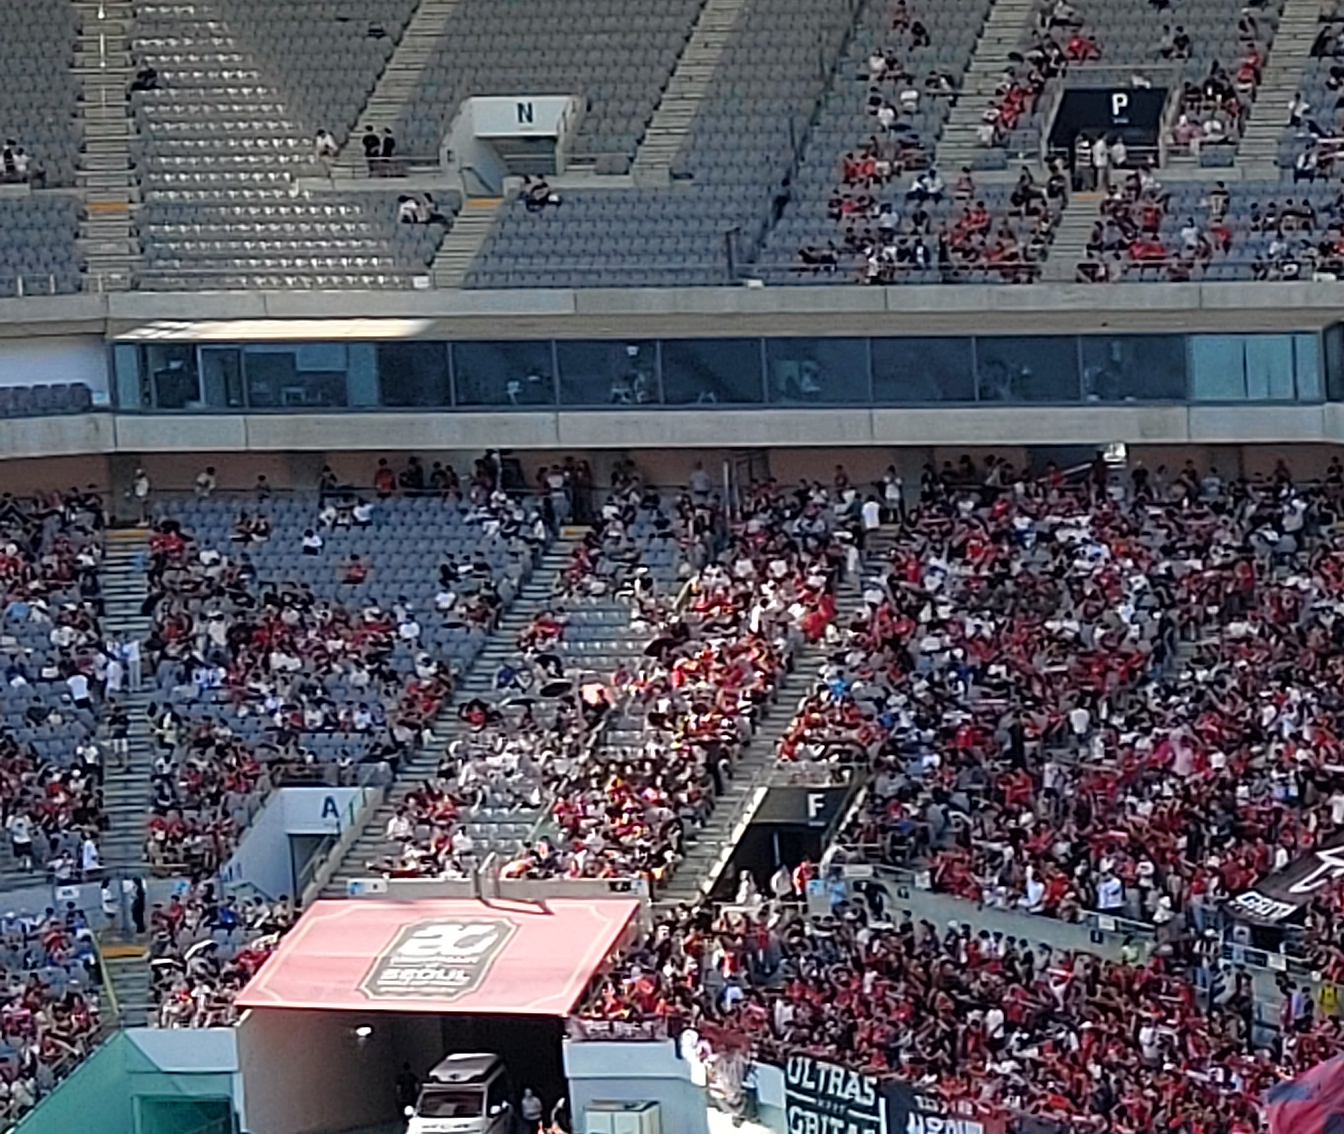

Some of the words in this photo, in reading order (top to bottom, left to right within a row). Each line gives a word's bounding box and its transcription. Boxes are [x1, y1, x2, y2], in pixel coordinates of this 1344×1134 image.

[517, 102, 534, 123] N
[1112, 93, 1128, 115] P
[321, 795, 339, 818] A
[808, 793, 826, 817] F
[787, 1056, 878, 1108] ULTRAS
